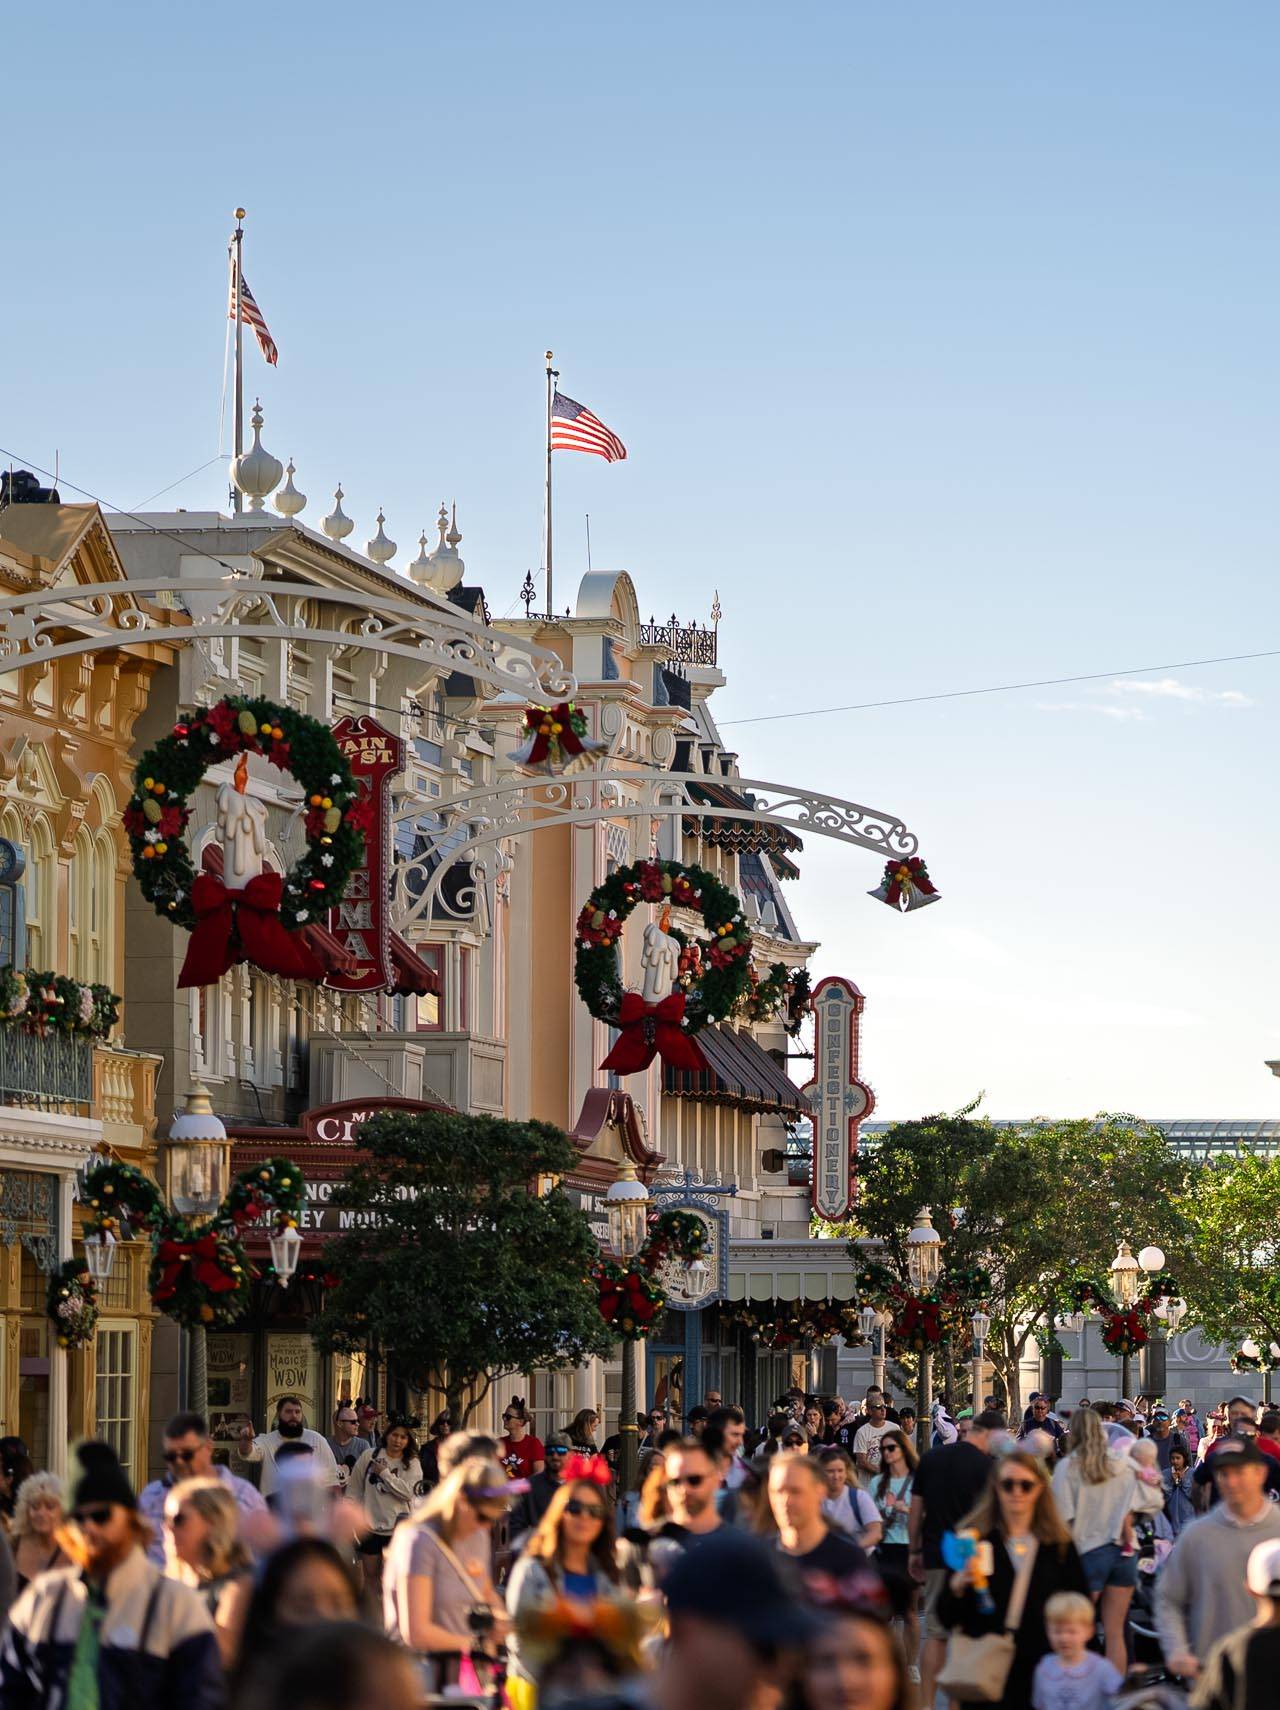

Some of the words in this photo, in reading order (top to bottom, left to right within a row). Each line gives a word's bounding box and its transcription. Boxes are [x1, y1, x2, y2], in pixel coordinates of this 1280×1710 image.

[337, 736, 388, 753] AIN
[825, 1003, 841, 1204] CONFECTIONERY
[270, 1353, 300, 1368] MAGIC
[274, 1368, 307, 1387] WDW
